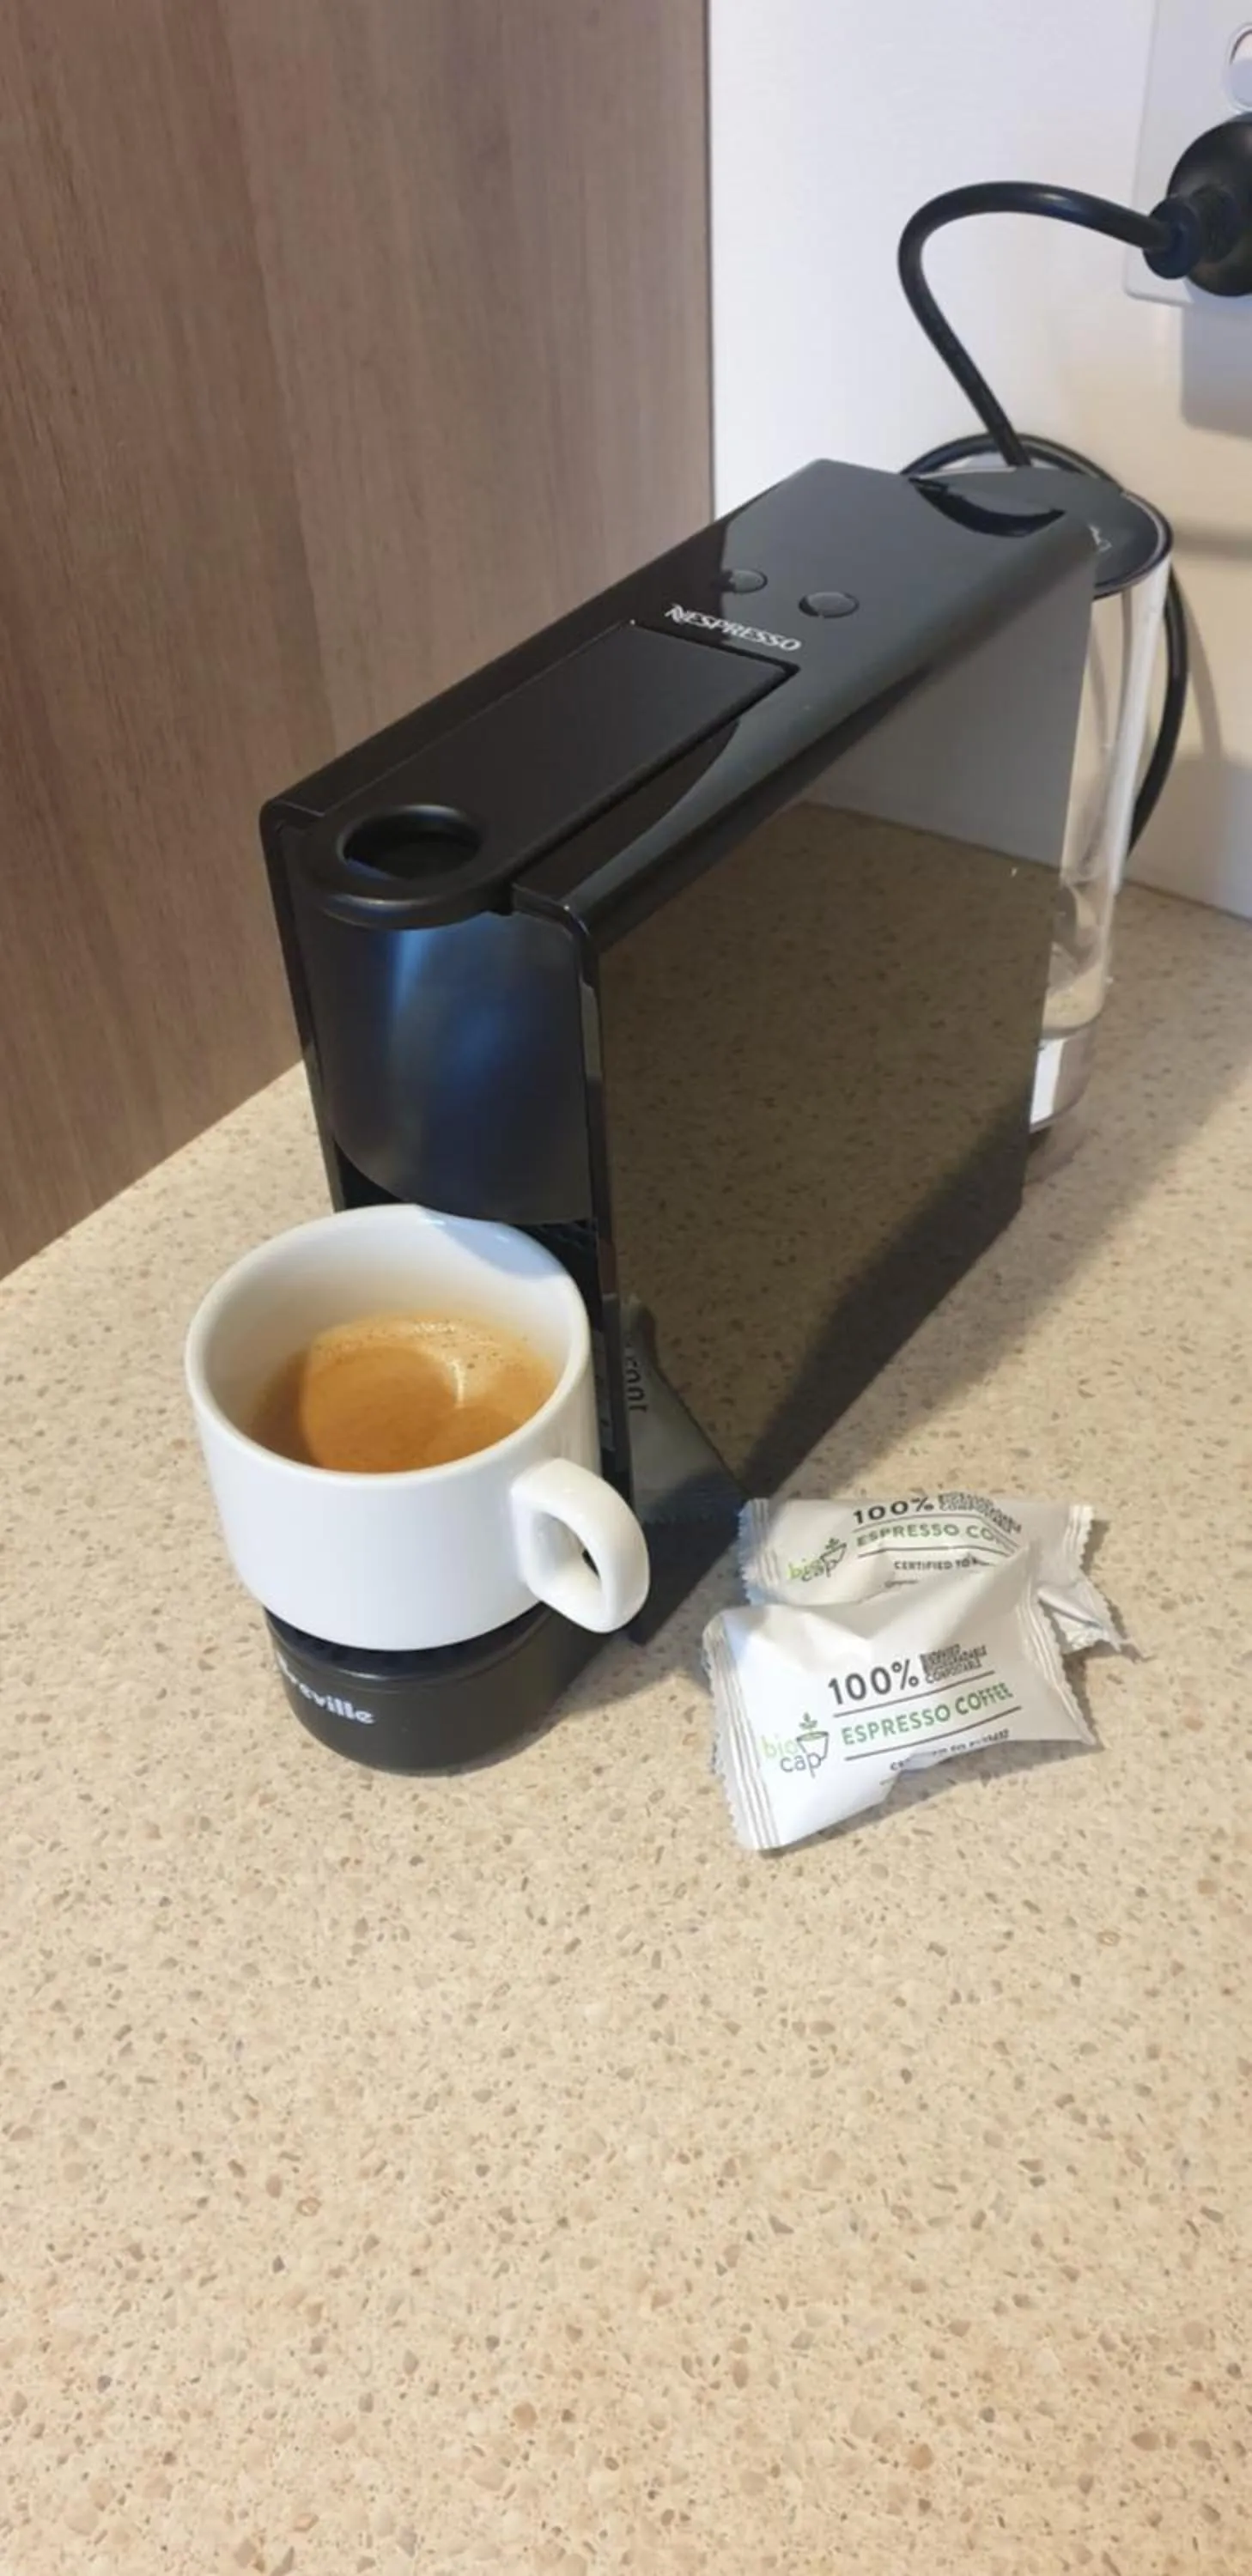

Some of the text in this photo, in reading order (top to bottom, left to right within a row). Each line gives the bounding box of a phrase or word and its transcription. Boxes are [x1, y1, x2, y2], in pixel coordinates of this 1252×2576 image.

[664, 604, 802, 651] NESPRESSO
[853, 1497, 935, 1524] 100%
[856, 1523, 960, 1546] ESPRESSO
[828, 1659, 919, 1705] 100%
[841, 1682, 1013, 1746] ESPRESSO COFFEE
[760, 1733, 799, 1759] bio
[780, 1752, 822, 1779] cap
